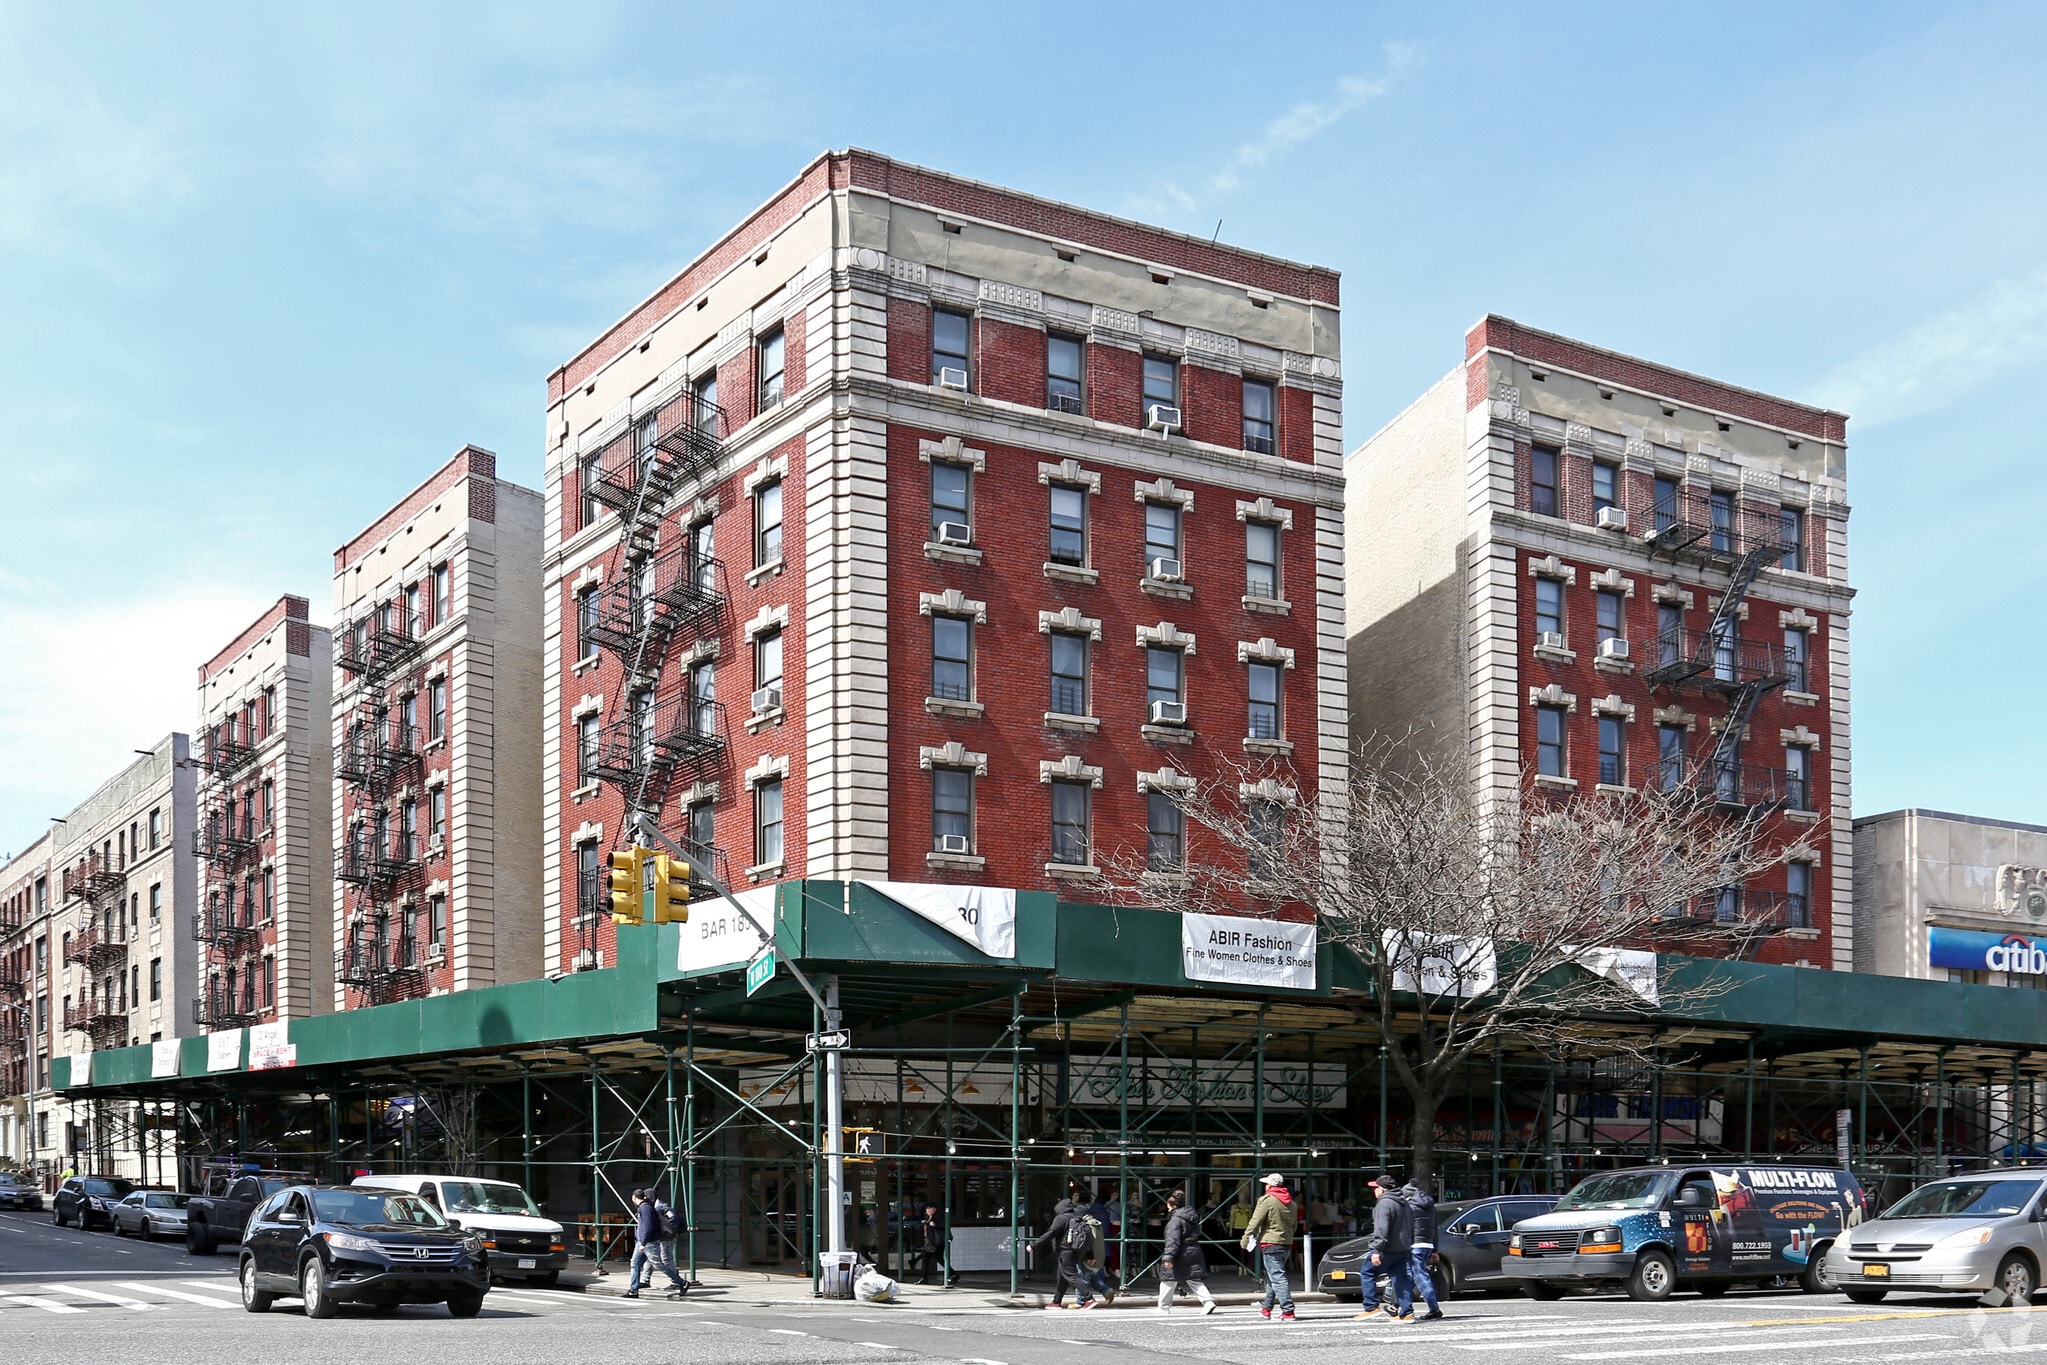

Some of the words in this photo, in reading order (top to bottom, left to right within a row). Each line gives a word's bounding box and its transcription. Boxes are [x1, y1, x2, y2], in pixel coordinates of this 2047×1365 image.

[701, 918, 727, 940] BAR
[1208, 930, 1241, 947] ABIR
[1244, 933, 1292, 951] Fashion
[1186, 947, 1205, 959] Fine
[1207, 949, 1240, 962] Women
[1242, 953, 1275, 965] Clothes
[1277, 955, 1284, 966] &
[1286, 956, 1313, 968] Shoes
[1985, 940, 2047, 975] citib
[276, 1046, 291, 1056] RENT
[1748, 1170, 1837, 1188] MULTI-FLOW
[1775, 1211, 1784, 1219] Go
[1784, 1211, 1797, 1219] with
[1797, 1211, 1807, 1219] the
